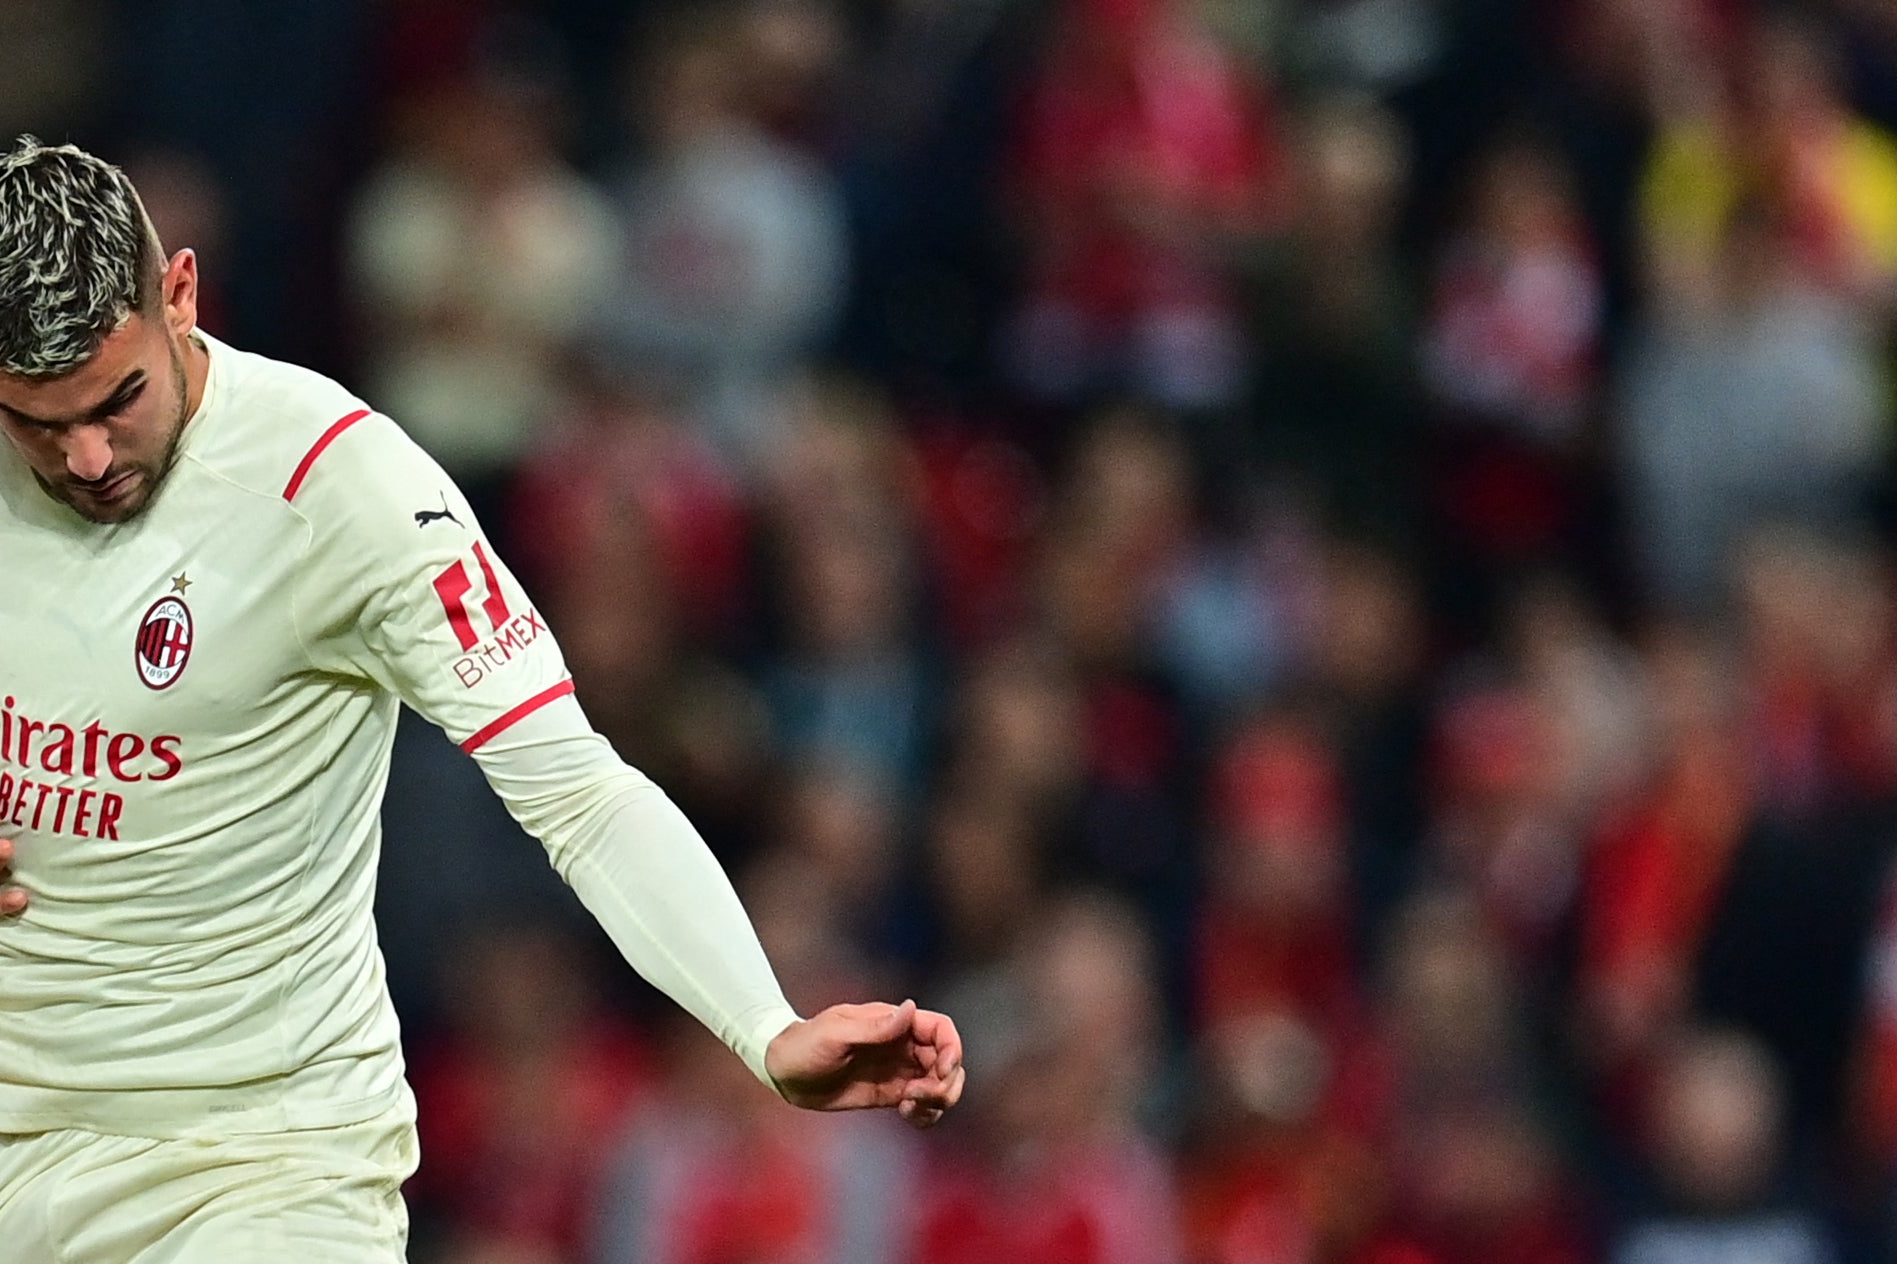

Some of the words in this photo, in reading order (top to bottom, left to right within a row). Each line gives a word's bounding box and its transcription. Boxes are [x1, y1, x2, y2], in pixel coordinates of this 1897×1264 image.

[155, 604, 185, 624] ACM
[453, 607, 547, 689] BitMEX
[144, 666, 171, 679] 1899
